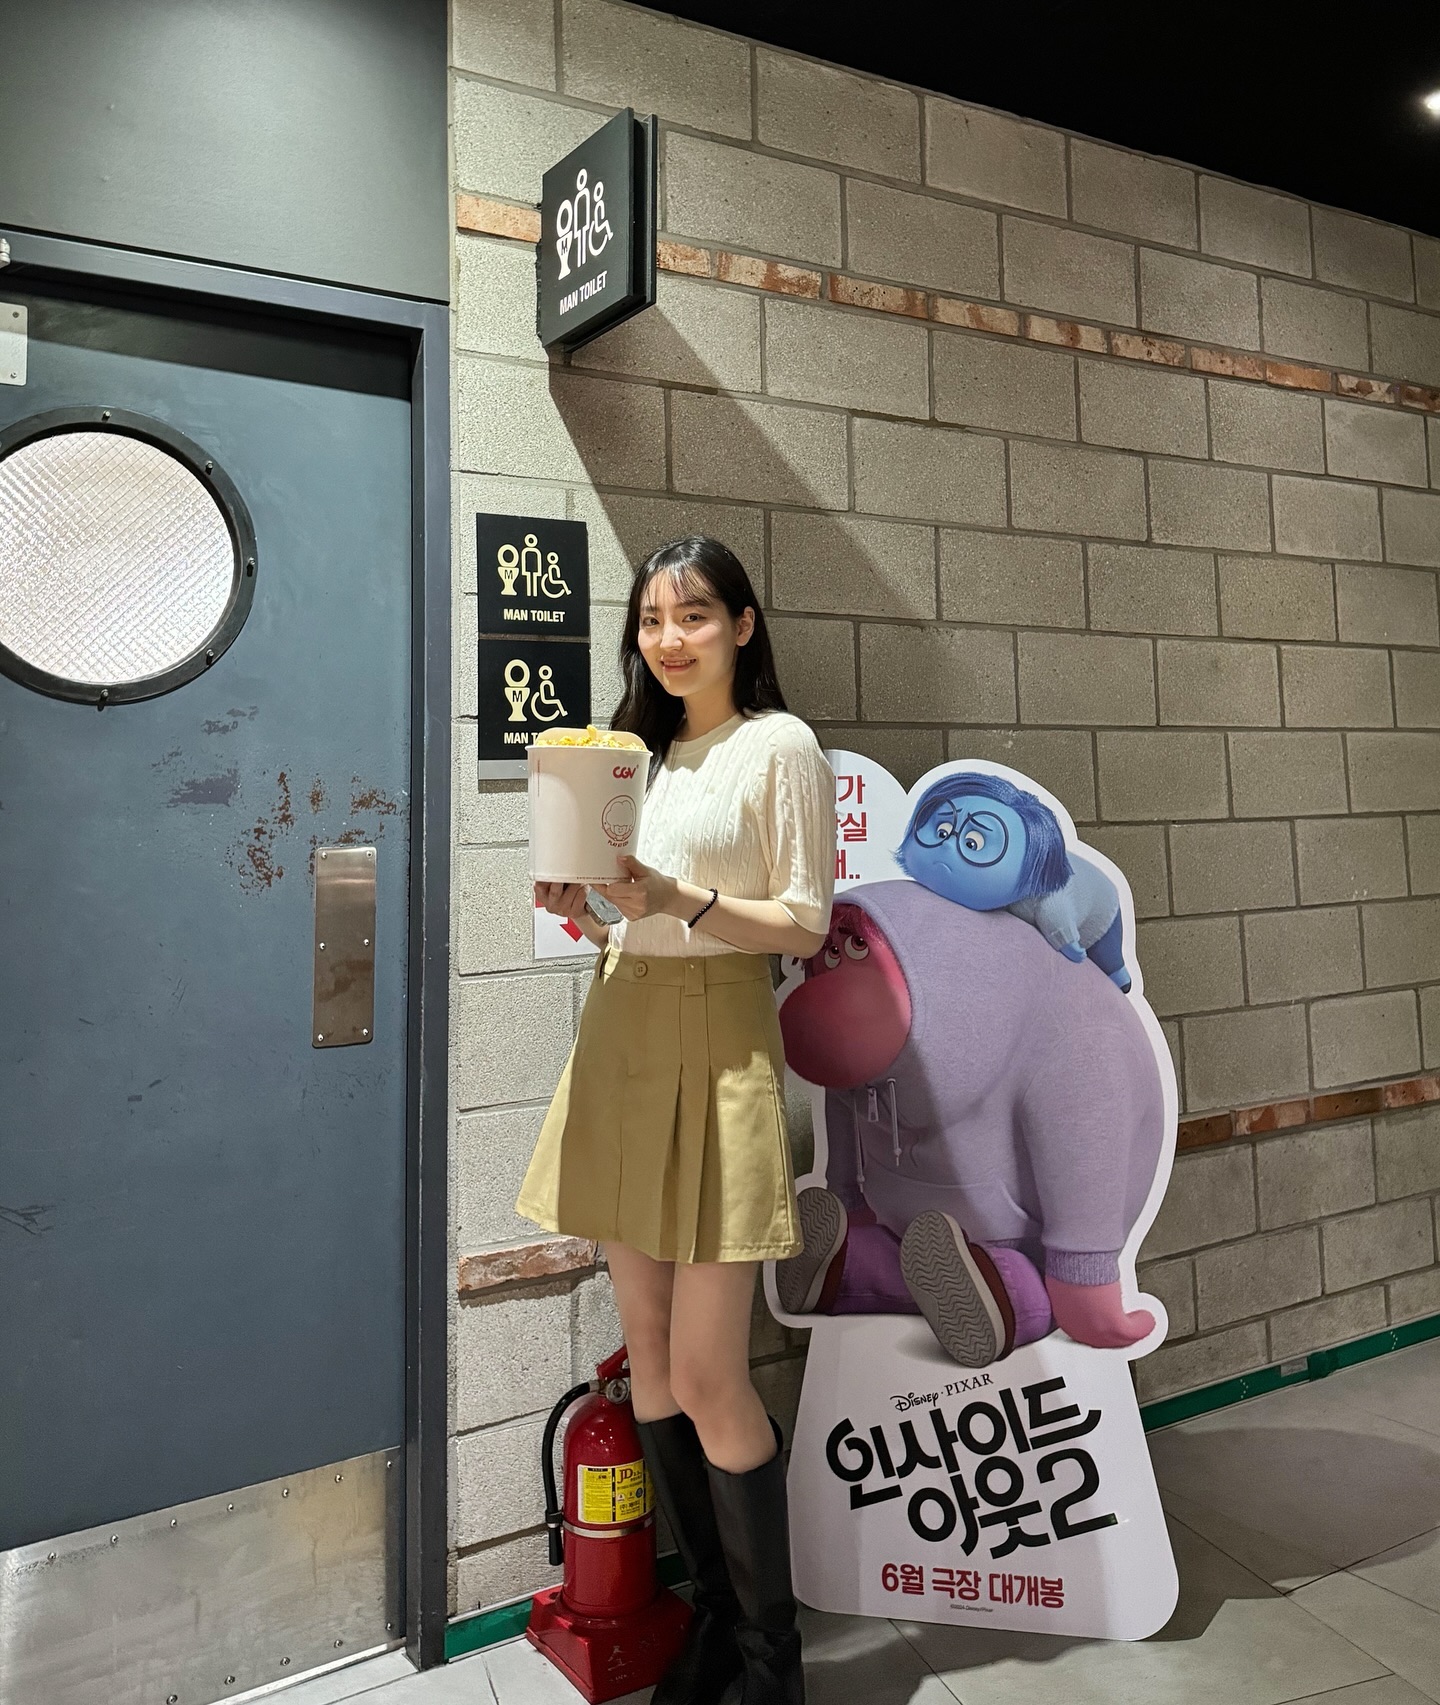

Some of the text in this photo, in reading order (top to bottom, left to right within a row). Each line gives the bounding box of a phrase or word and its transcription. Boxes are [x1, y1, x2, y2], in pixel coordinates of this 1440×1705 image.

[560, 270, 608, 316] MAN TOILET
[504, 569, 514, 580] M
[503, 608, 566, 623] MAN TOILET
[512, 690, 523, 703] M
[504, 732, 529, 744] MAN
[612, 765, 637, 779] CGV
[834, 774, 866, 805] 가
[835, 812, 868, 842] 실
[944, 1373, 994, 1397] PIXAR
[826, 1376, 1102, 1510] 인사이드
[617, 1468, 633, 1483] JD
[907, 1448, 1118, 1560] 아웃2
[881, 1563, 1065, 1609] 6월 극장 대개봉
